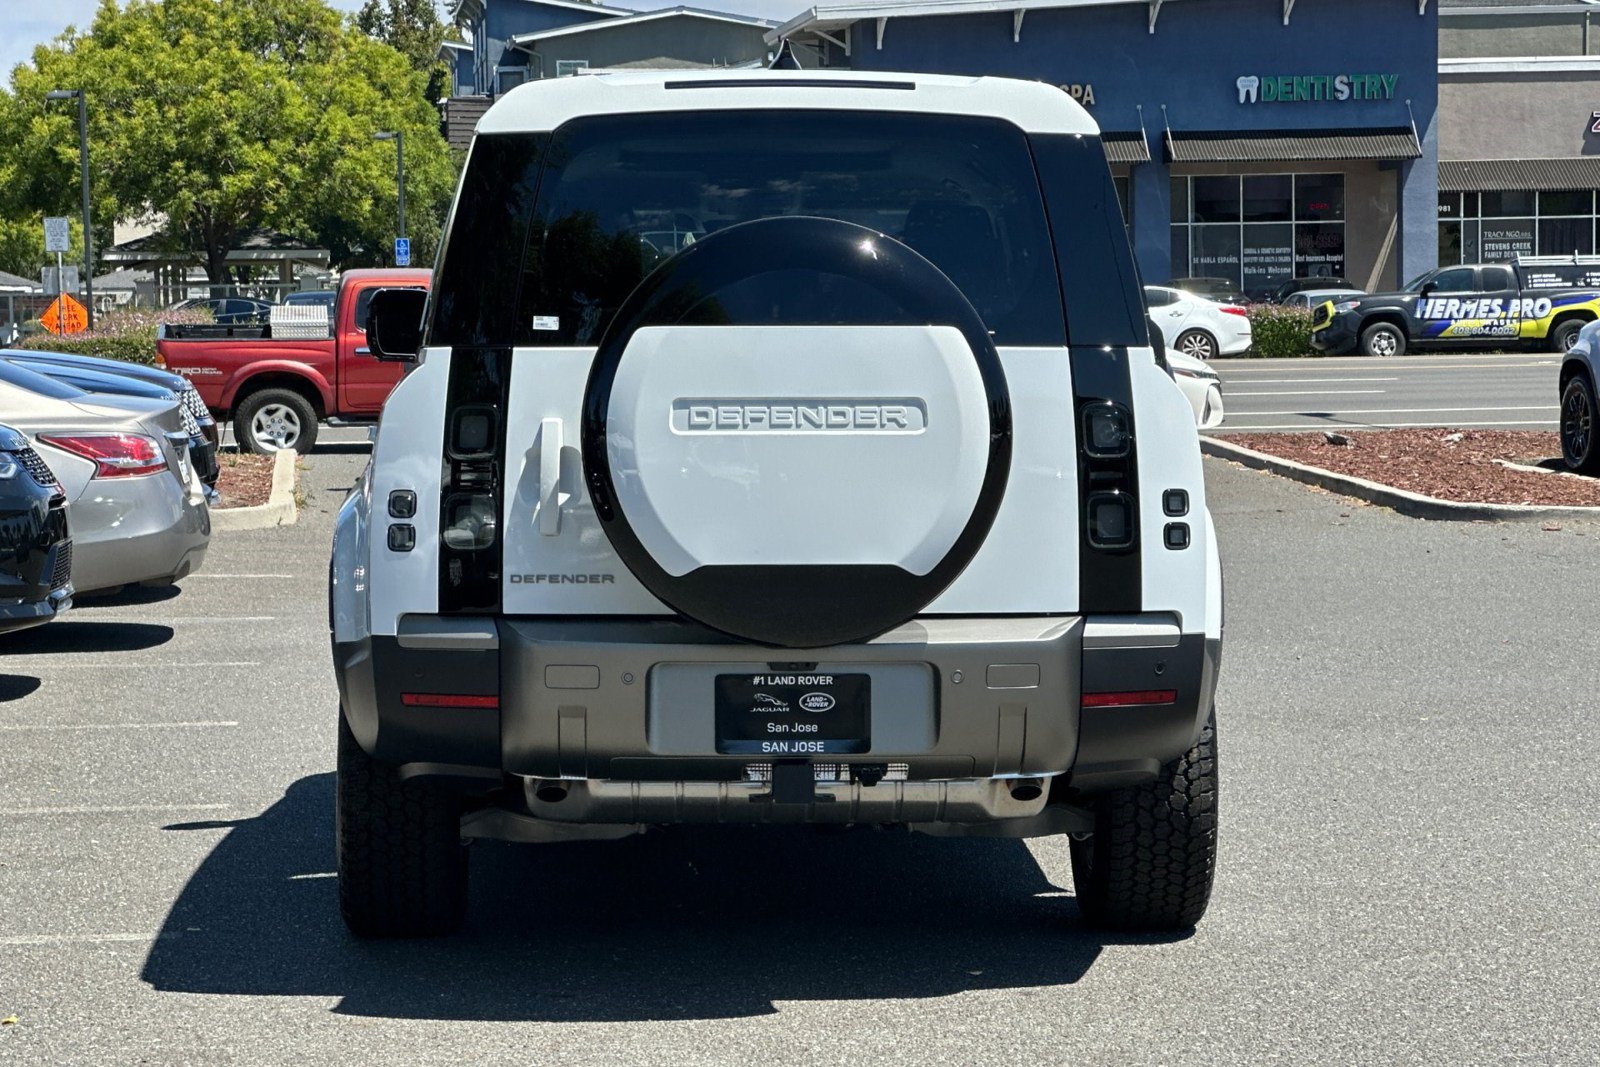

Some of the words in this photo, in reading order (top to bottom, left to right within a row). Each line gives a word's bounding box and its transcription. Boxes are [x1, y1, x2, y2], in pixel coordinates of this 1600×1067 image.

[1261, 74, 1399, 102] DENTISTRY
[1512, 242, 1531, 250] CREEK
[1218, 254, 1238, 264] ESPAÑOL
[1268, 266, 1291, 274] Welcome
[688, 405, 909, 429] DEFENDER
[510, 574, 615, 584] DEFENDER
[753, 676, 764, 685] #1
[768, 676, 795, 685] LAND
[798, 676, 833, 685] ROVER
[767, 722, 789, 732] San
[791, 722, 818, 732] Jose
[762, 742, 788, 752] SAN
[791, 742, 824, 752] JOSE
